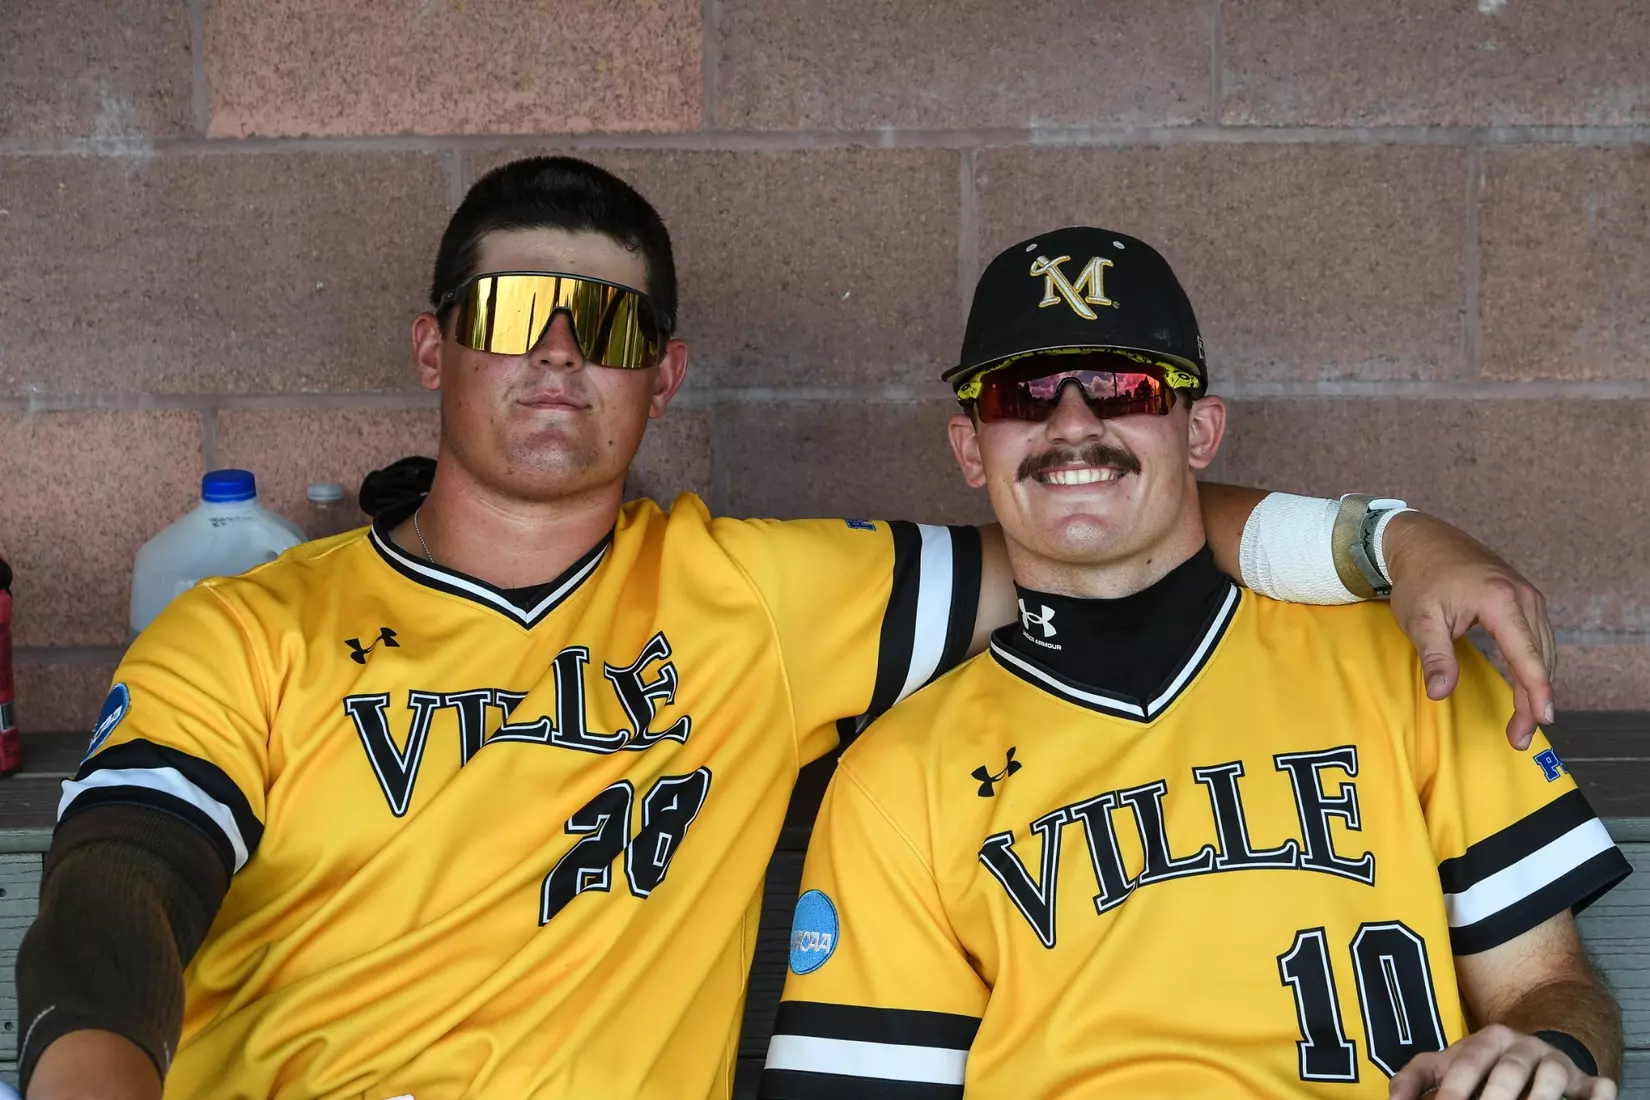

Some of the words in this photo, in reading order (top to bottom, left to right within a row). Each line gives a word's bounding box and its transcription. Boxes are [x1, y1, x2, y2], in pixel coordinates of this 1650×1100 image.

[343, 631, 691, 817] VILLE
[1035, 639, 1062, 650] ARMOUR
[1533, 748, 1568, 782] P
[538, 766, 712, 927] 28
[978, 745, 1375, 949] VILLE
[1276, 920, 1448, 1083] 10
